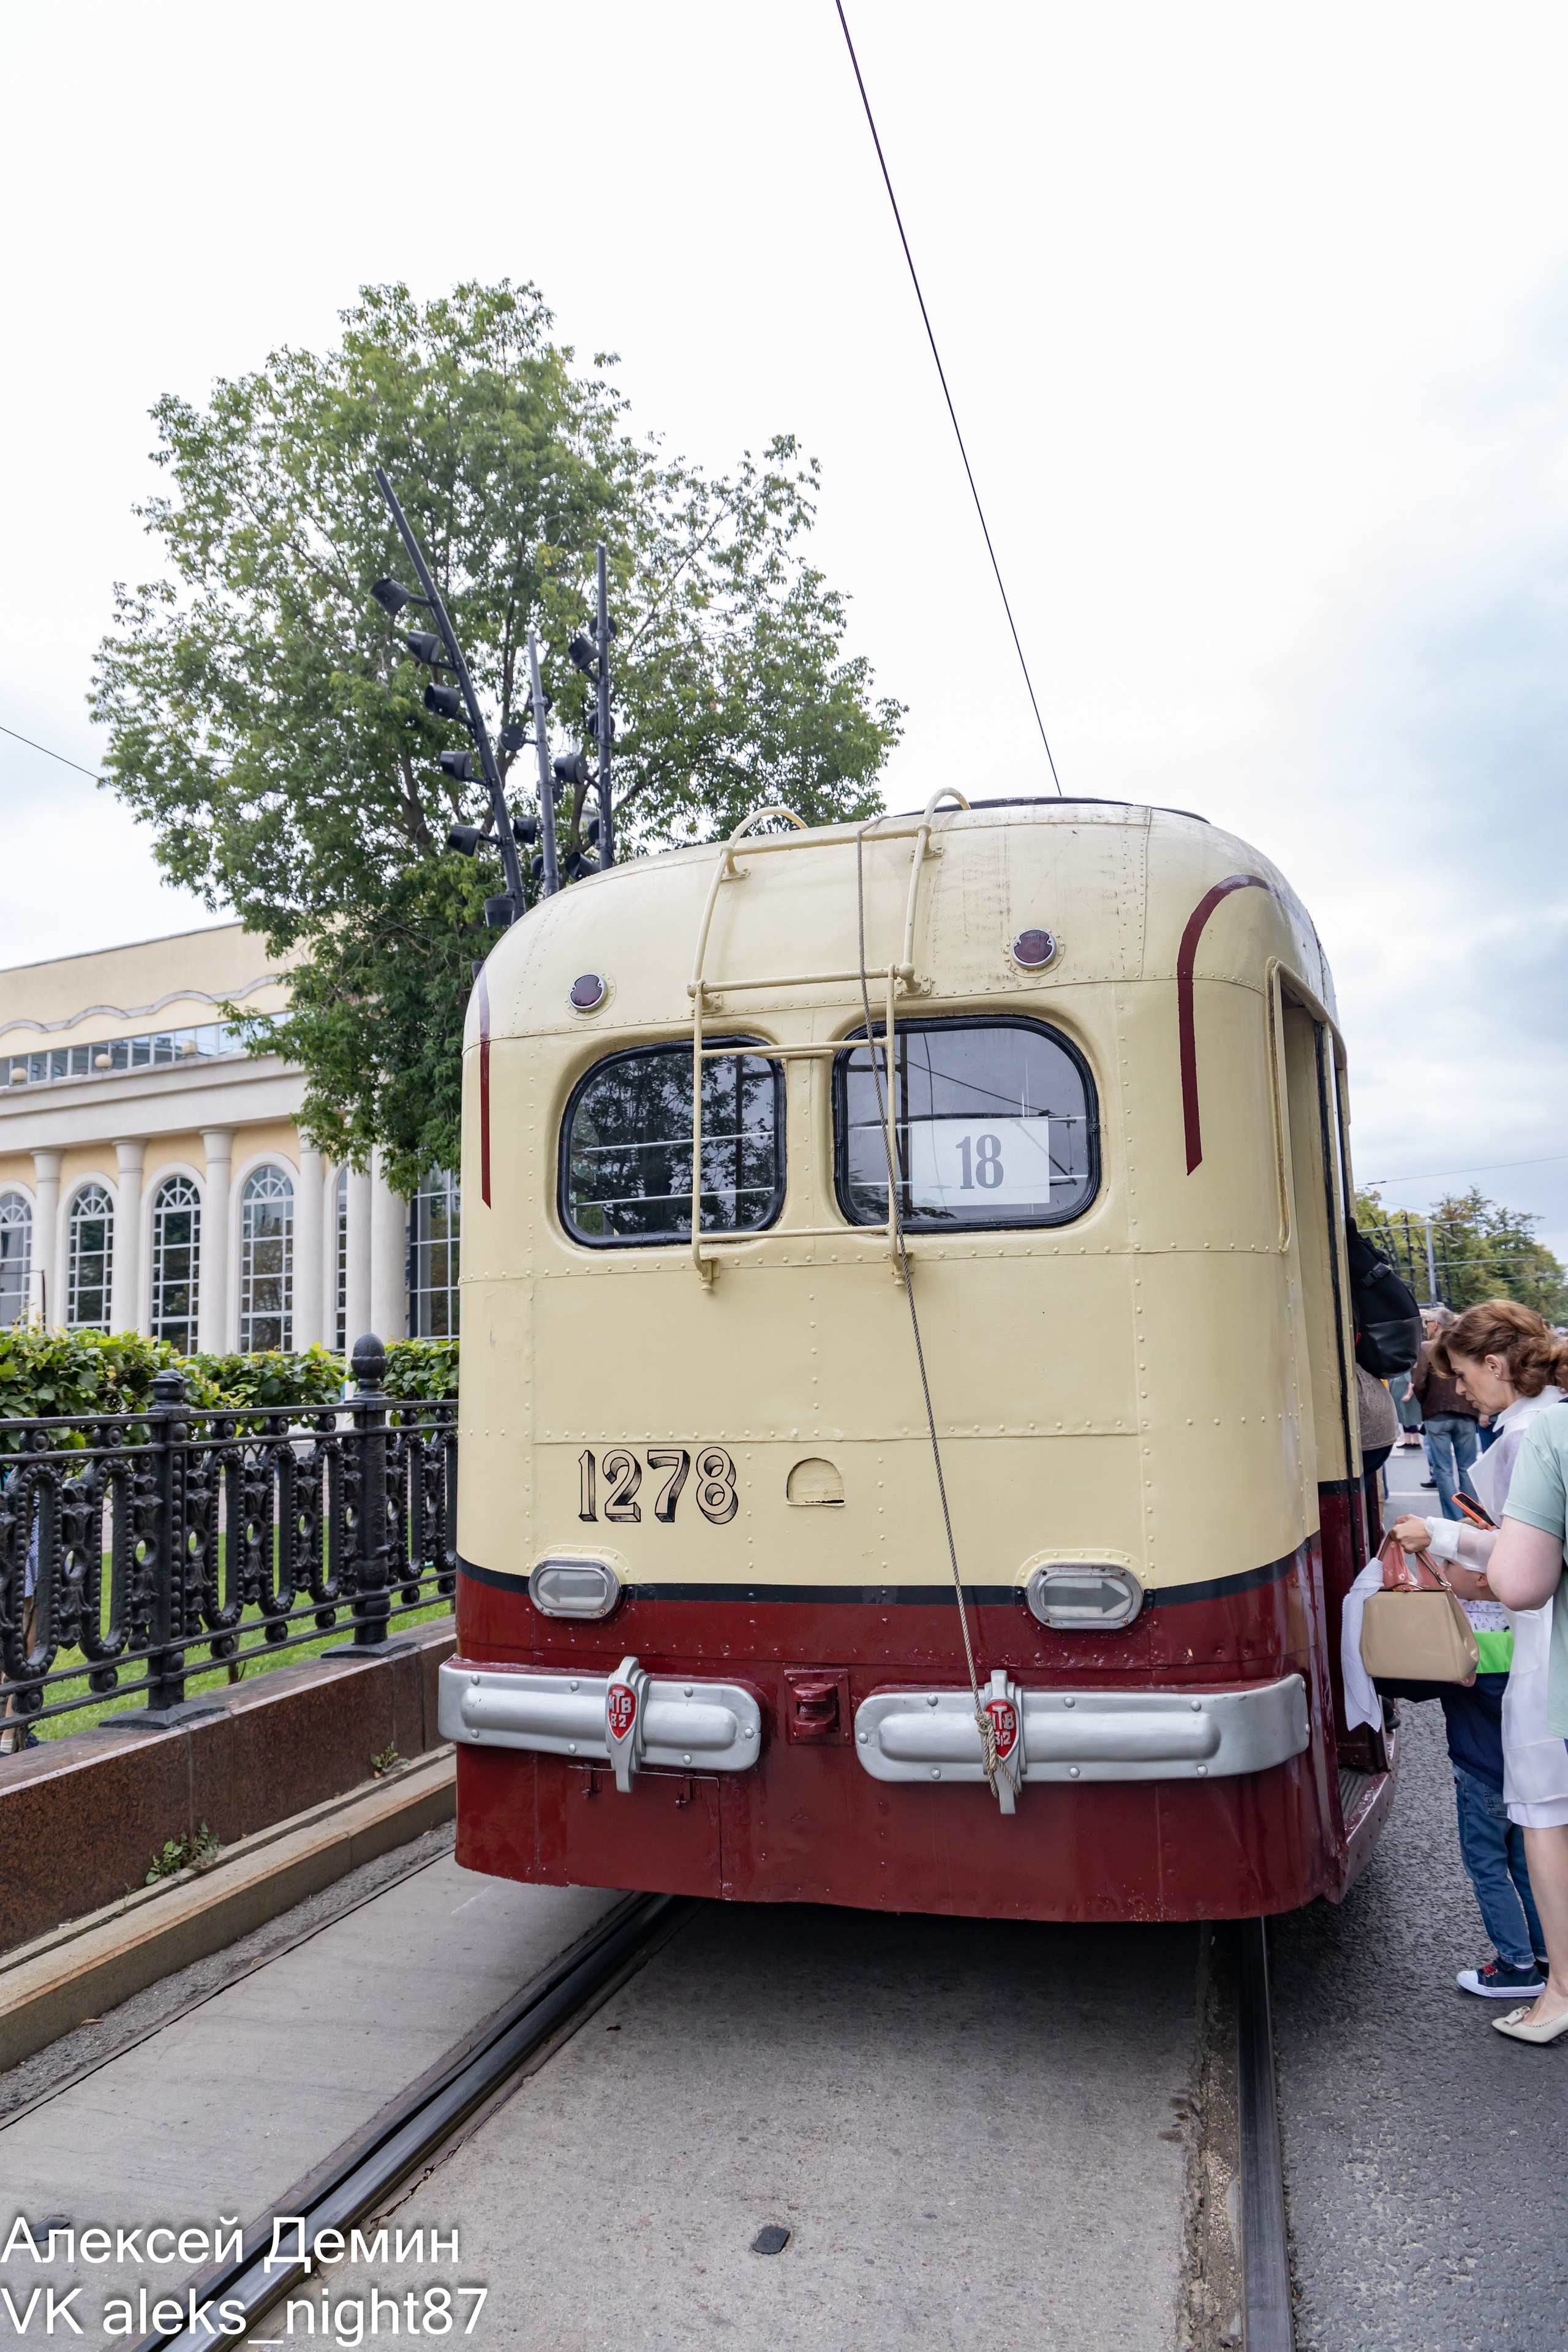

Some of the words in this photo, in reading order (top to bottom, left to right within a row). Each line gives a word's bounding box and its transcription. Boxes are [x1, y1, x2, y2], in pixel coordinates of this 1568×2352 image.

[956, 1134, 1004, 1189] 18
[578, 1446, 739, 1525] 1278
[610, 1714, 627, 1727] 82
